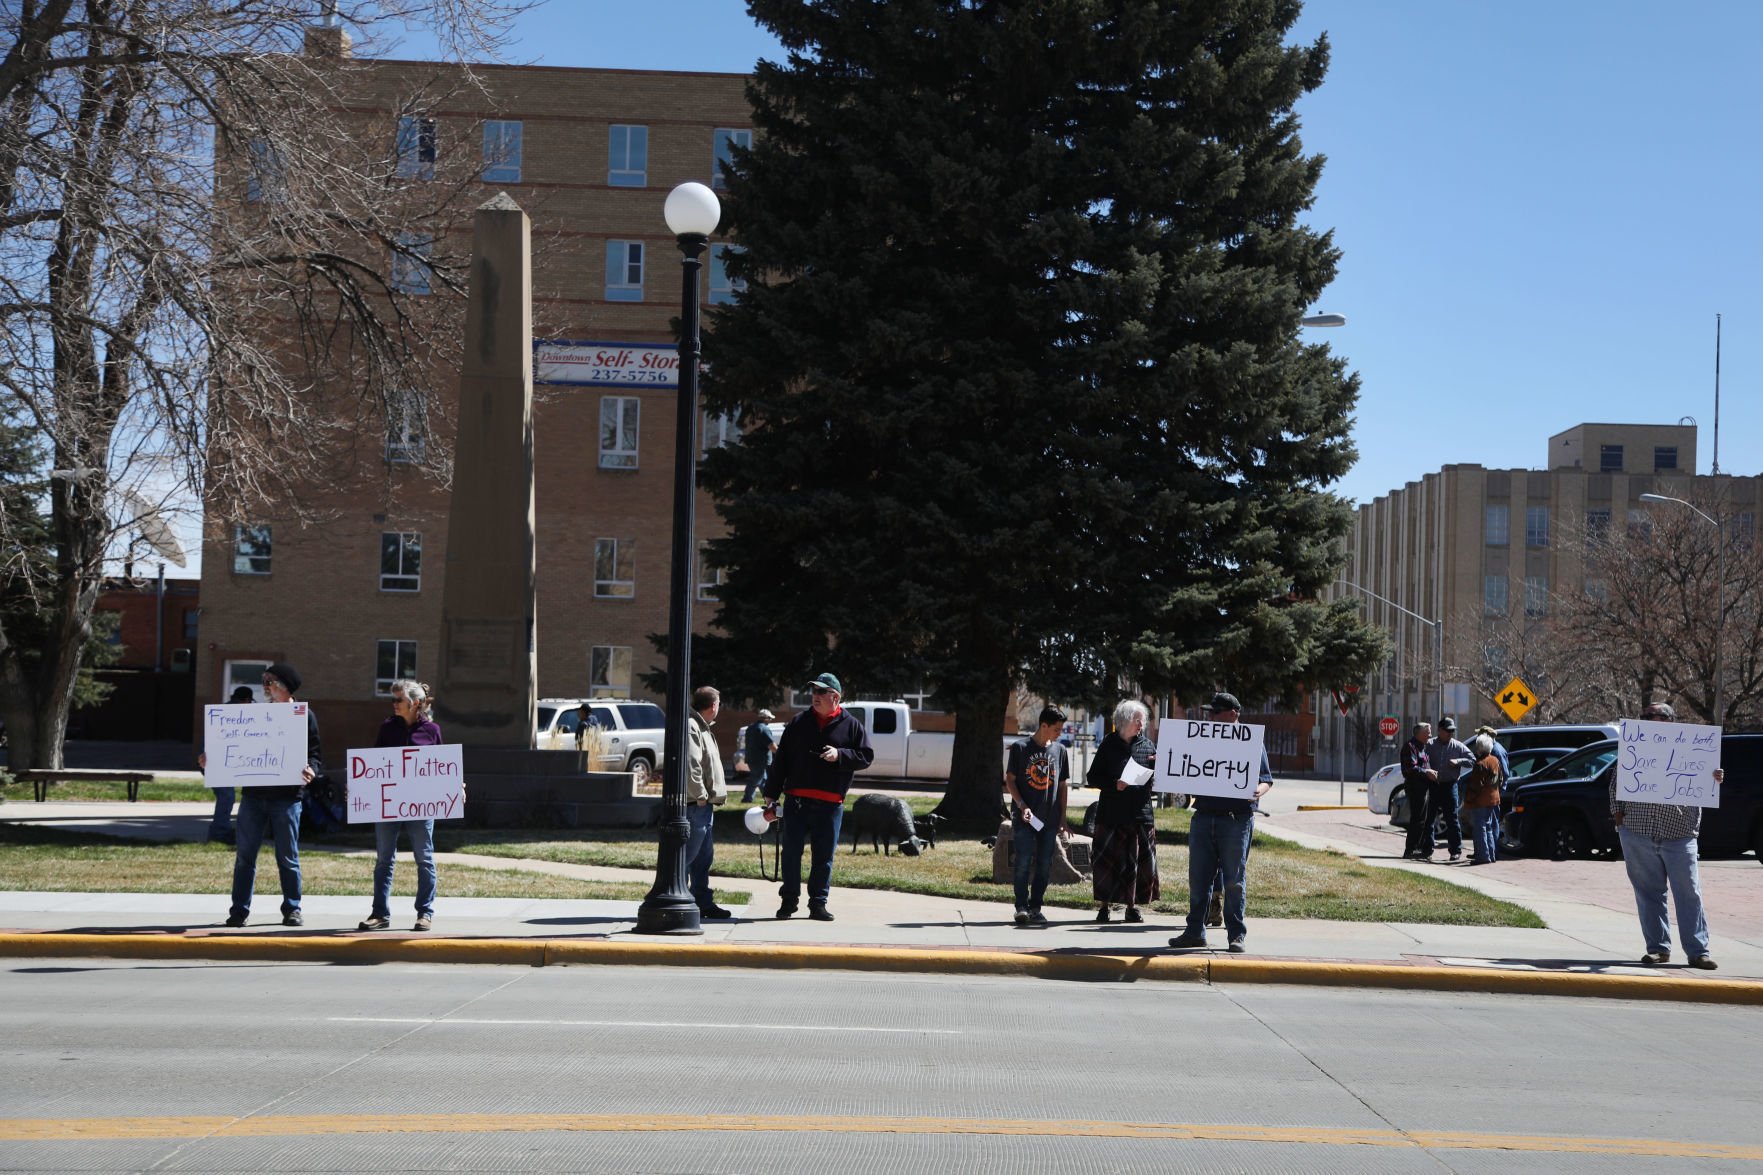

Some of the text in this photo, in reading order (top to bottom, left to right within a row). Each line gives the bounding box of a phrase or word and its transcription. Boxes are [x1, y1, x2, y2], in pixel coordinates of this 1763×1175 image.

[541, 353, 591, 362] Downtown
[591, 369, 668, 382] 237-5756
[208, 708, 255, 726] Freedom
[1381, 722, 1398, 731] STOP
[1187, 721, 1252, 741] DEFEND
[1621, 721, 1716, 748] We can do both
[224, 744, 285, 769] Essential
[351, 748, 458, 779] Don't Flatten
[1621, 745, 1706, 771] Save Lives
[1167, 747, 1250, 790] Liberty
[1623, 771, 1658, 794] Save
[351, 796, 371, 812] the
